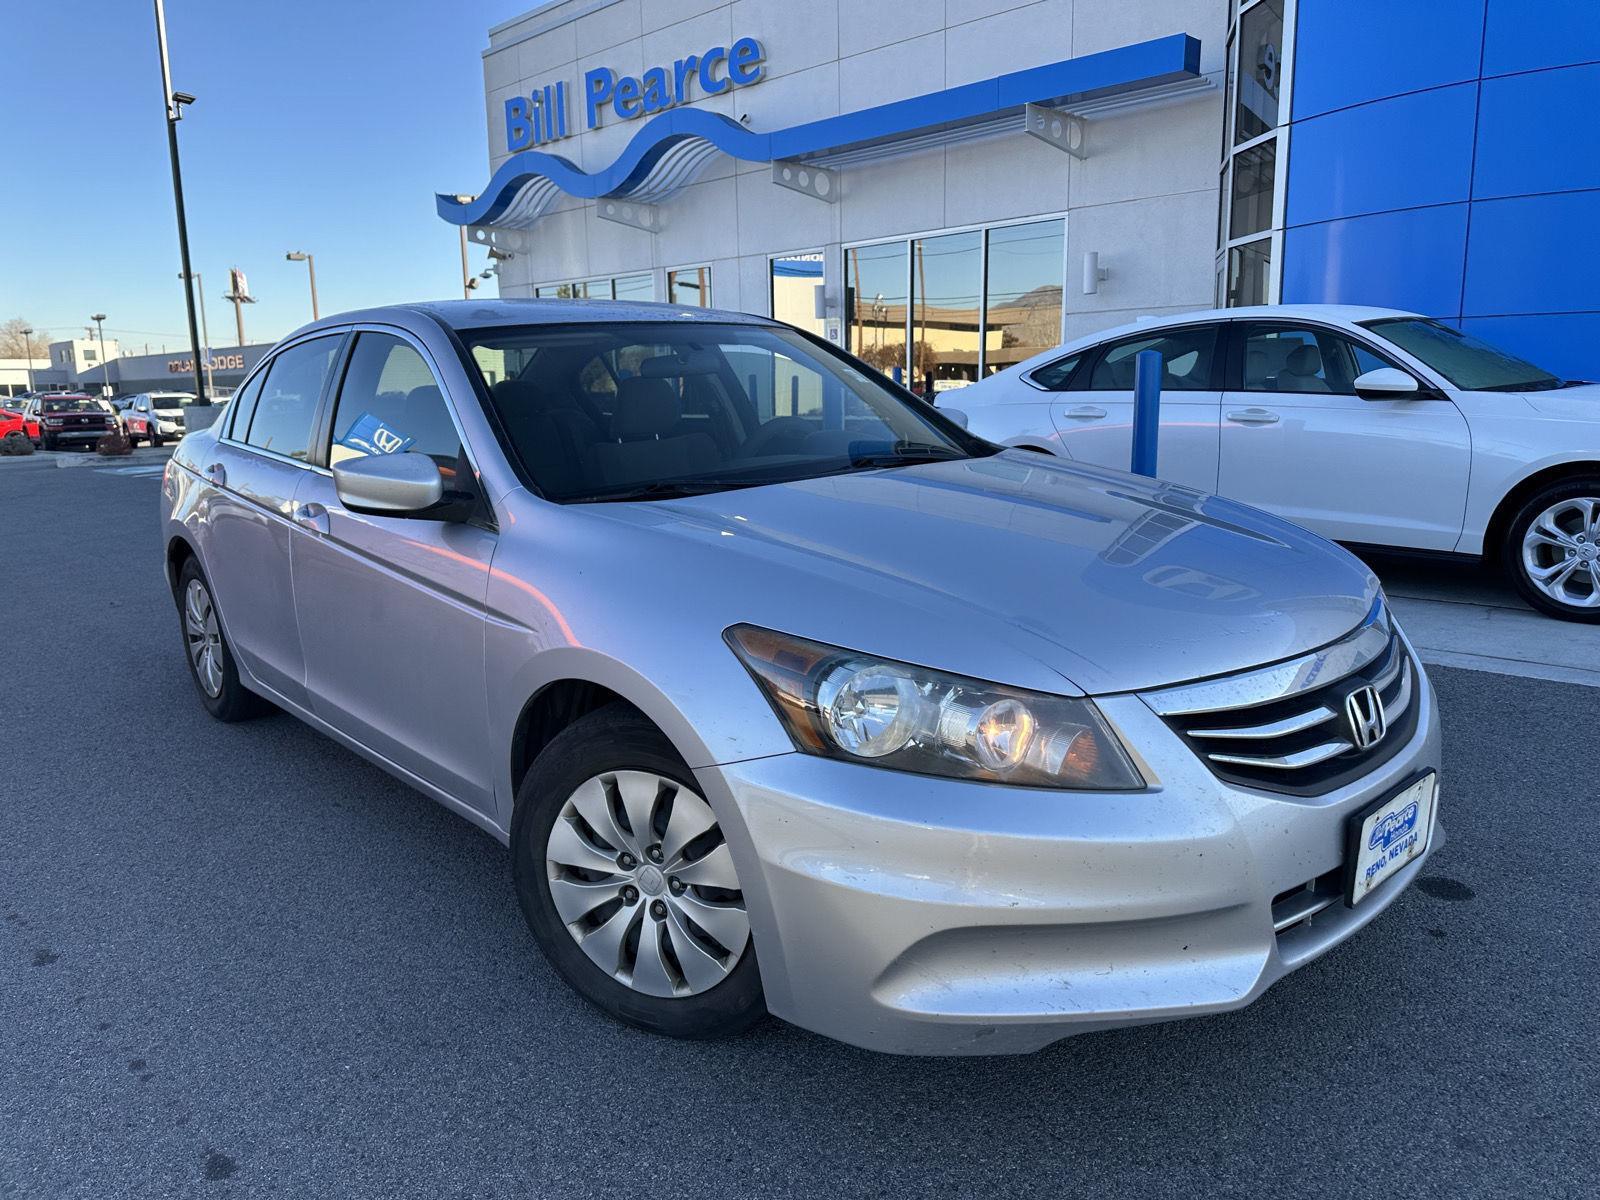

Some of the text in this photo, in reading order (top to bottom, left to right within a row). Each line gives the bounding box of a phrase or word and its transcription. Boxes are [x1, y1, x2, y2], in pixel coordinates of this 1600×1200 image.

[504, 36, 767, 153] Bill Pearce
[202, 354, 245, 371] ODGE
[1388, 831, 1418, 861] NEVADA
